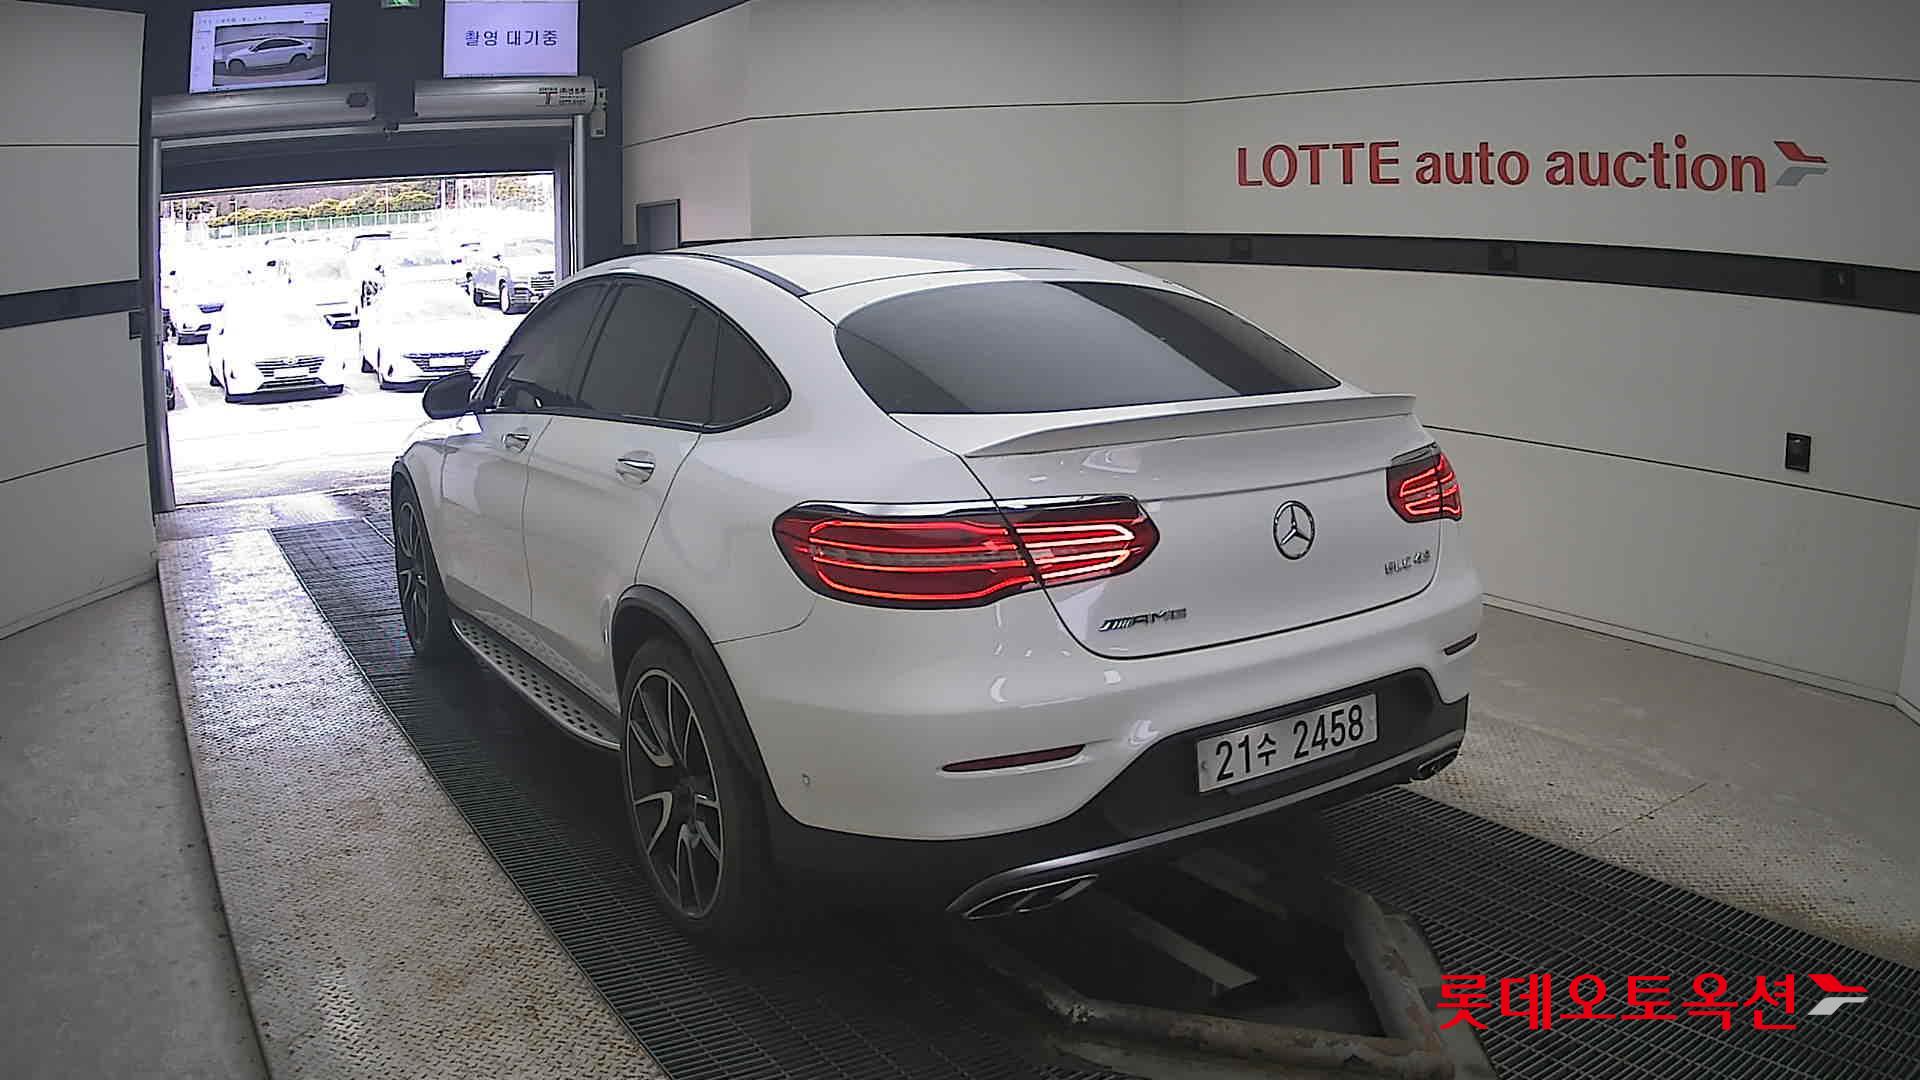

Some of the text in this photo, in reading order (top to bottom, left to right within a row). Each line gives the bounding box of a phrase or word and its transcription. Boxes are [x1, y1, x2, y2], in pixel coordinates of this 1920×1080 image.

[465, 30, 557, 47] 촬영 대기중
[1237, 135, 1767, 193] LOTTE auto auction
[1215, 704, 1364, 782] 21수 2458
